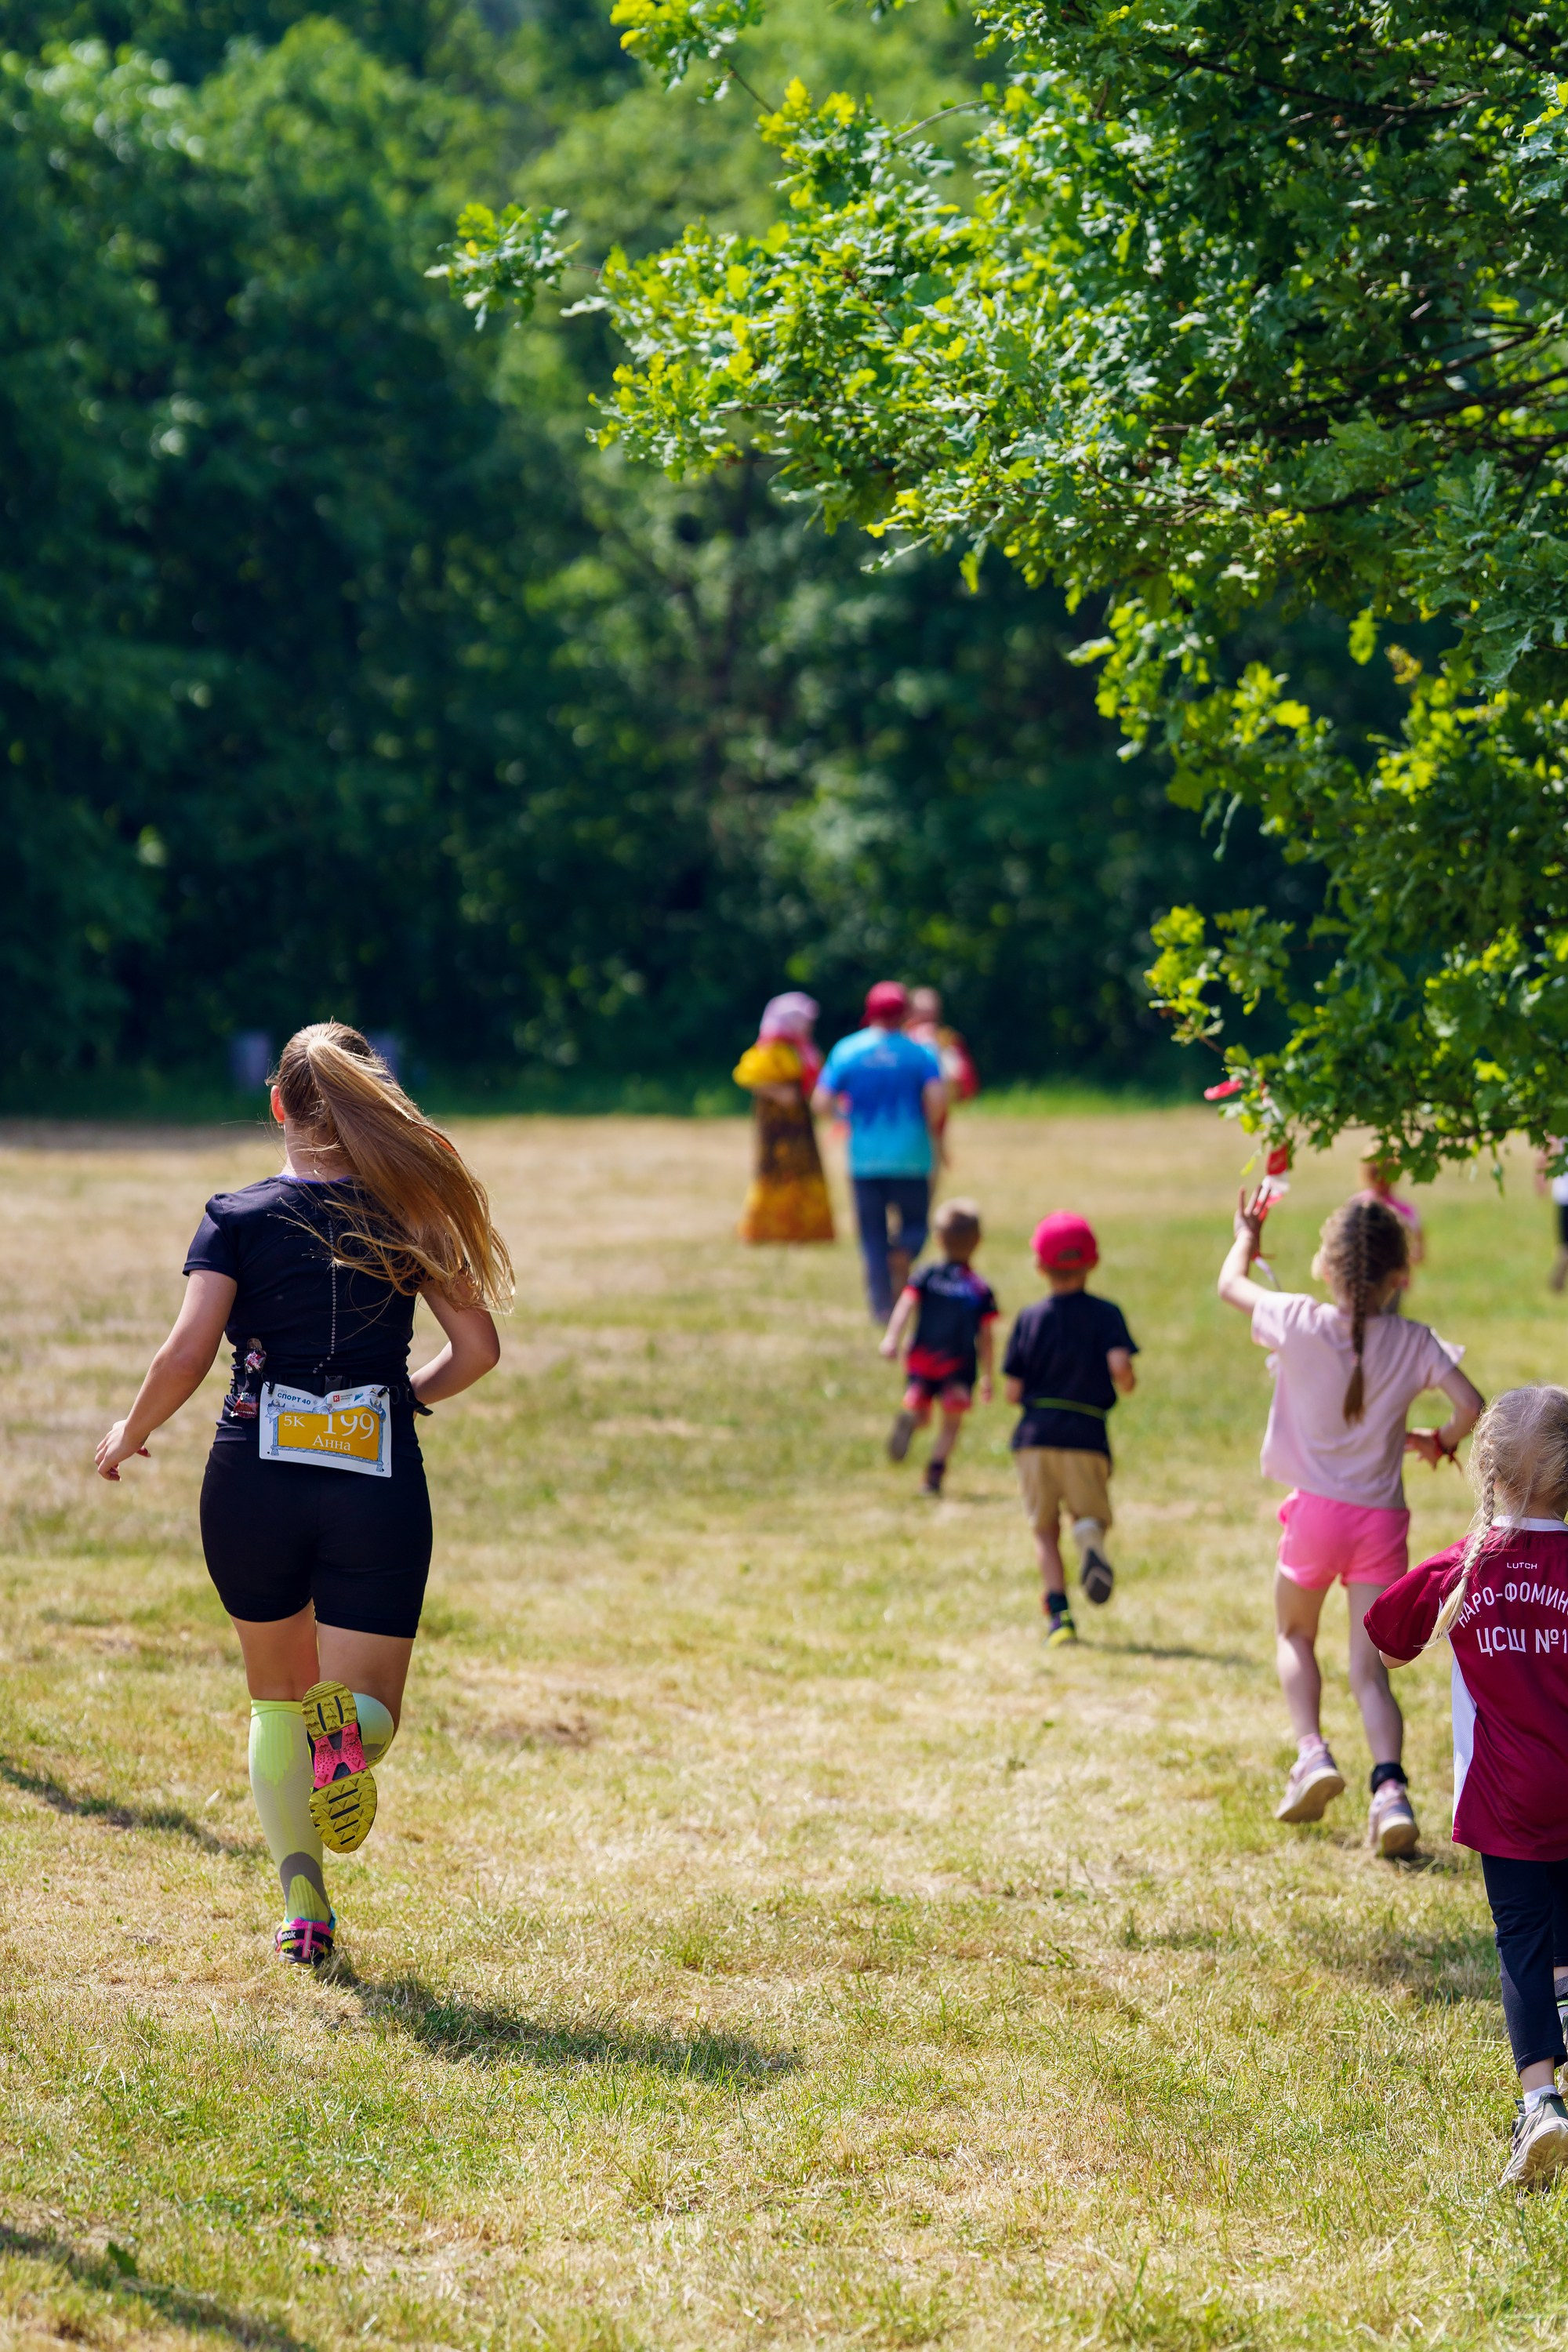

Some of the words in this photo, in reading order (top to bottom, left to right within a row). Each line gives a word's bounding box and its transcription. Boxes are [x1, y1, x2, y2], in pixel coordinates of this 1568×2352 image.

[277, 1392, 301, 1403] СПОРТ
[323, 1413, 375, 1440] 199
[312, 1435, 351, 1451] Анна
[1457, 1581, 1568, 1628] НАРО-ФОМИН
[1475, 1626, 1526, 1657] ЦСШ
